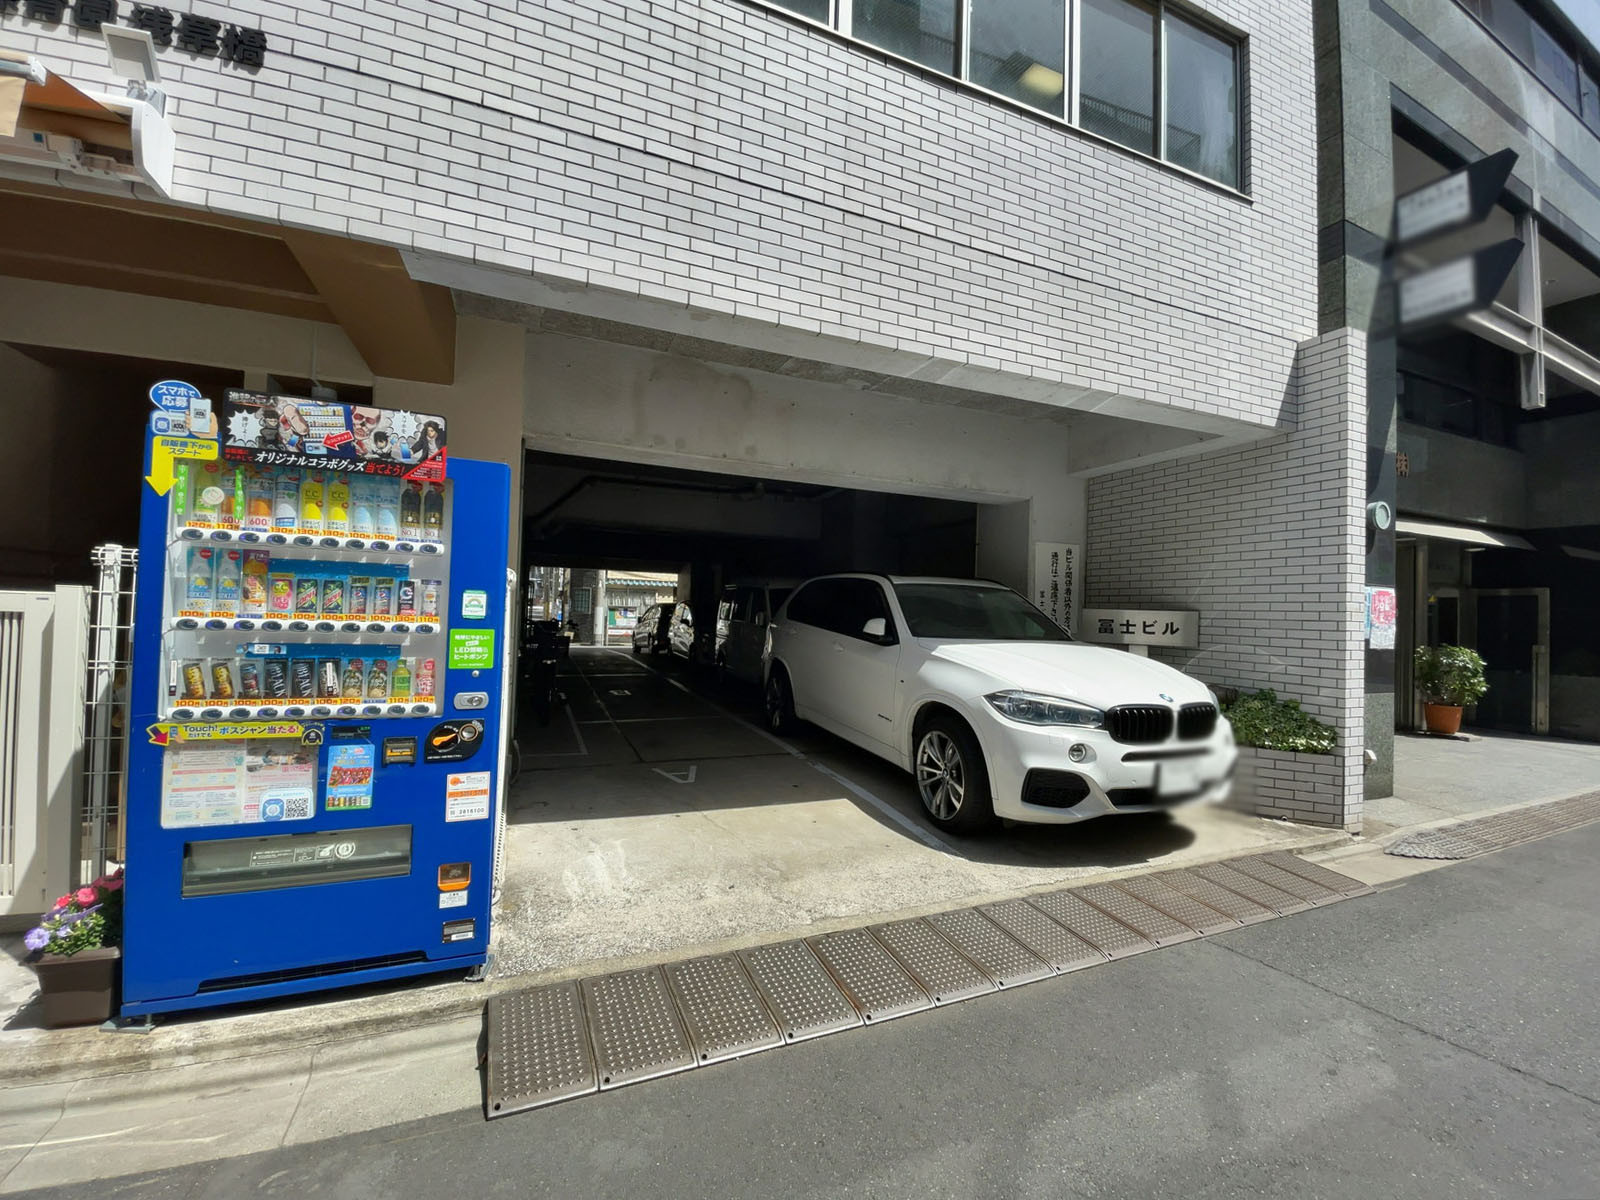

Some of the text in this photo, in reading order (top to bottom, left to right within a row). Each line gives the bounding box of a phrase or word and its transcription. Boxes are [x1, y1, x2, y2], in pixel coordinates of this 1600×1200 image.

[157, 385, 196, 398] スマホで
[167, 447, 202, 457] スタート
[183, 724, 218, 733] Touch!
